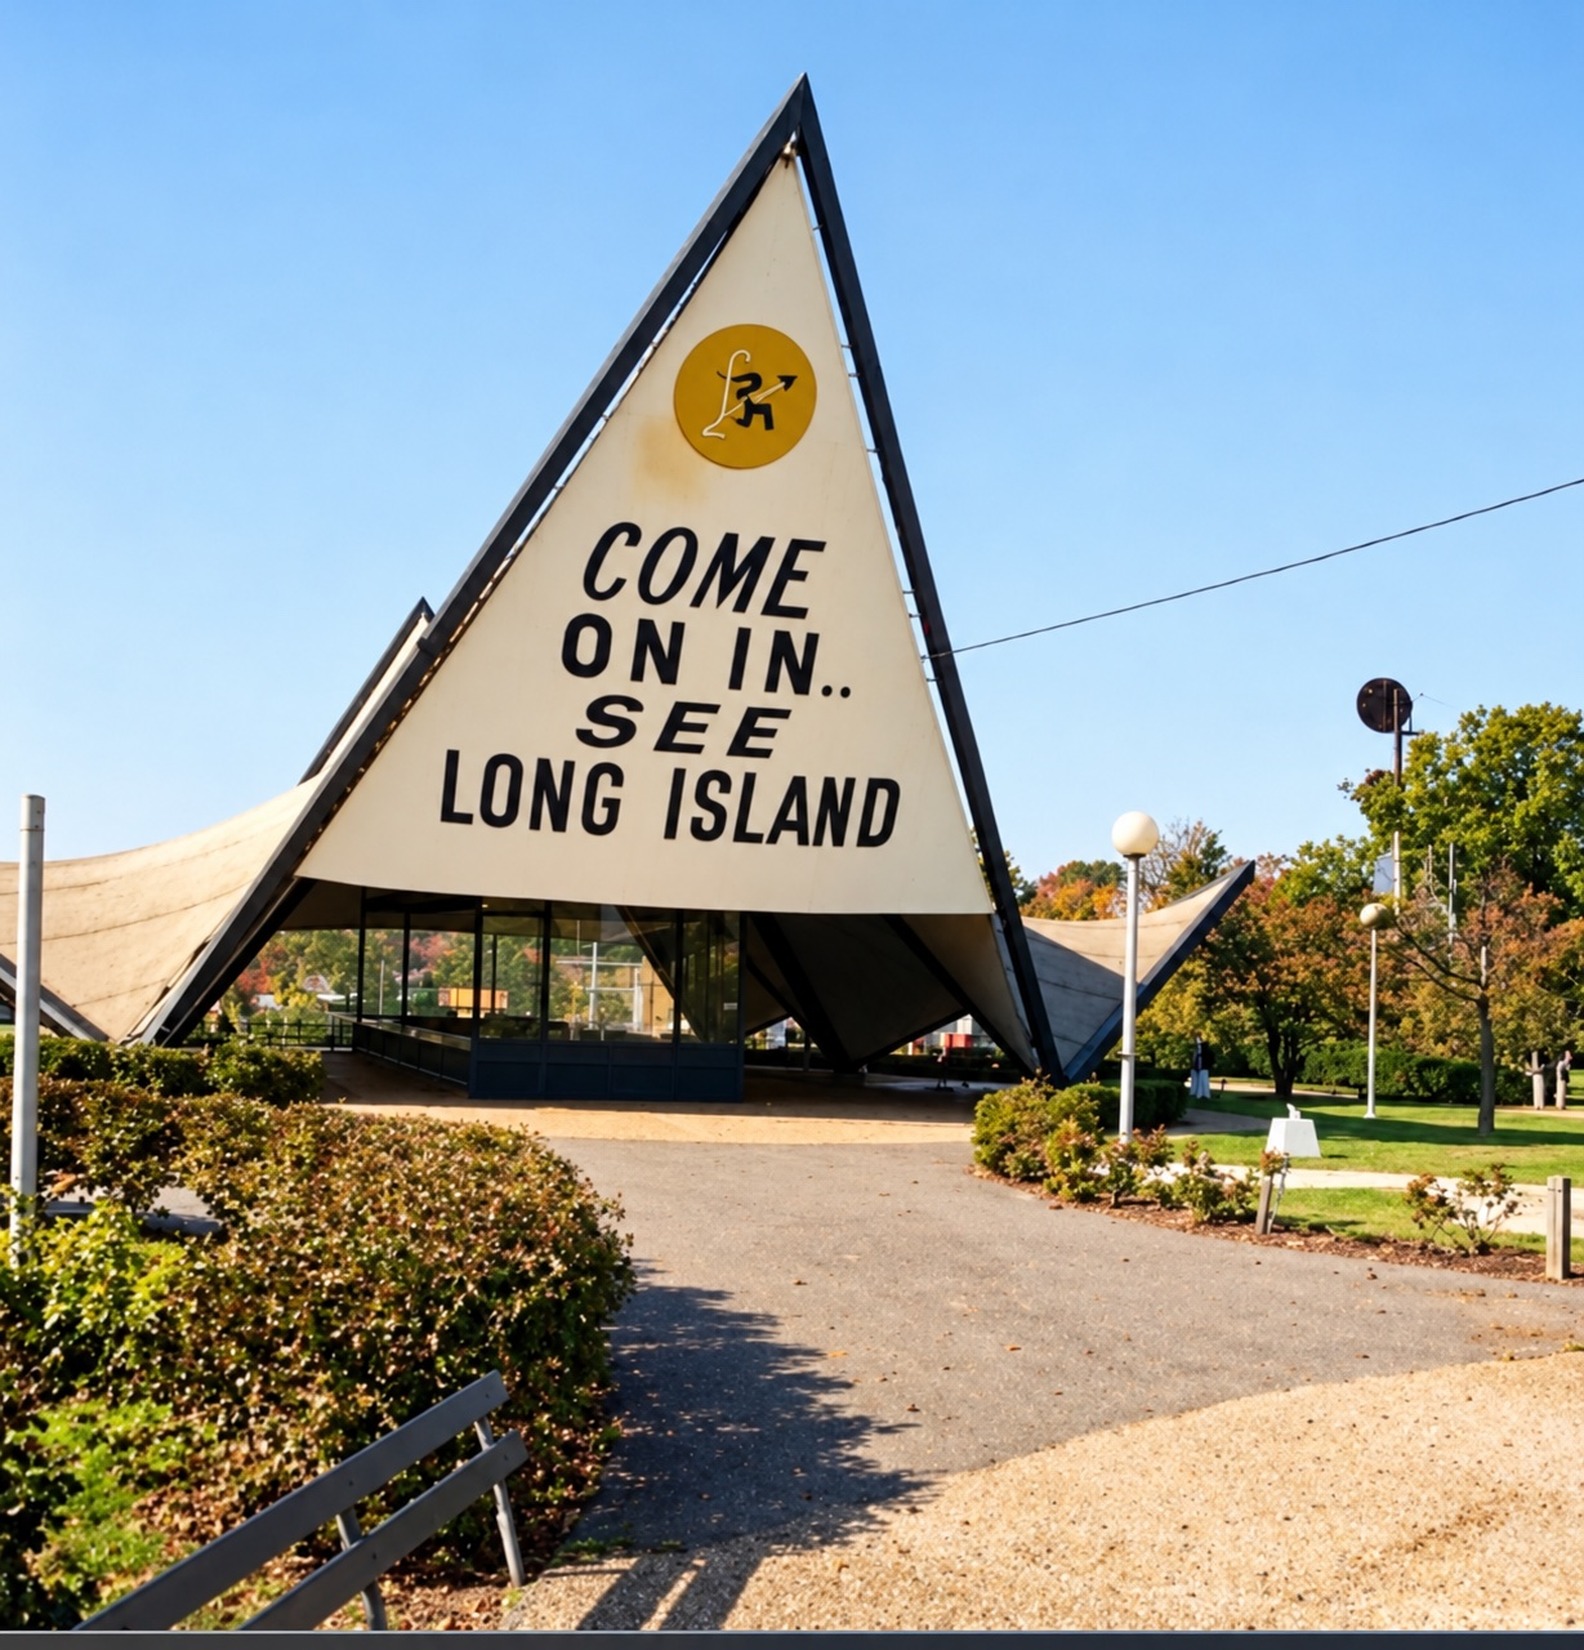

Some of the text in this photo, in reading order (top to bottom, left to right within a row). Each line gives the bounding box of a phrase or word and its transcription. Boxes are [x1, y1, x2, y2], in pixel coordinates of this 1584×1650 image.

[583, 521, 827, 619] COME
[561, 612, 686, 686] ON
[575, 694, 792, 759] SEE
[440, 749, 901, 848] LONG ISLAND
